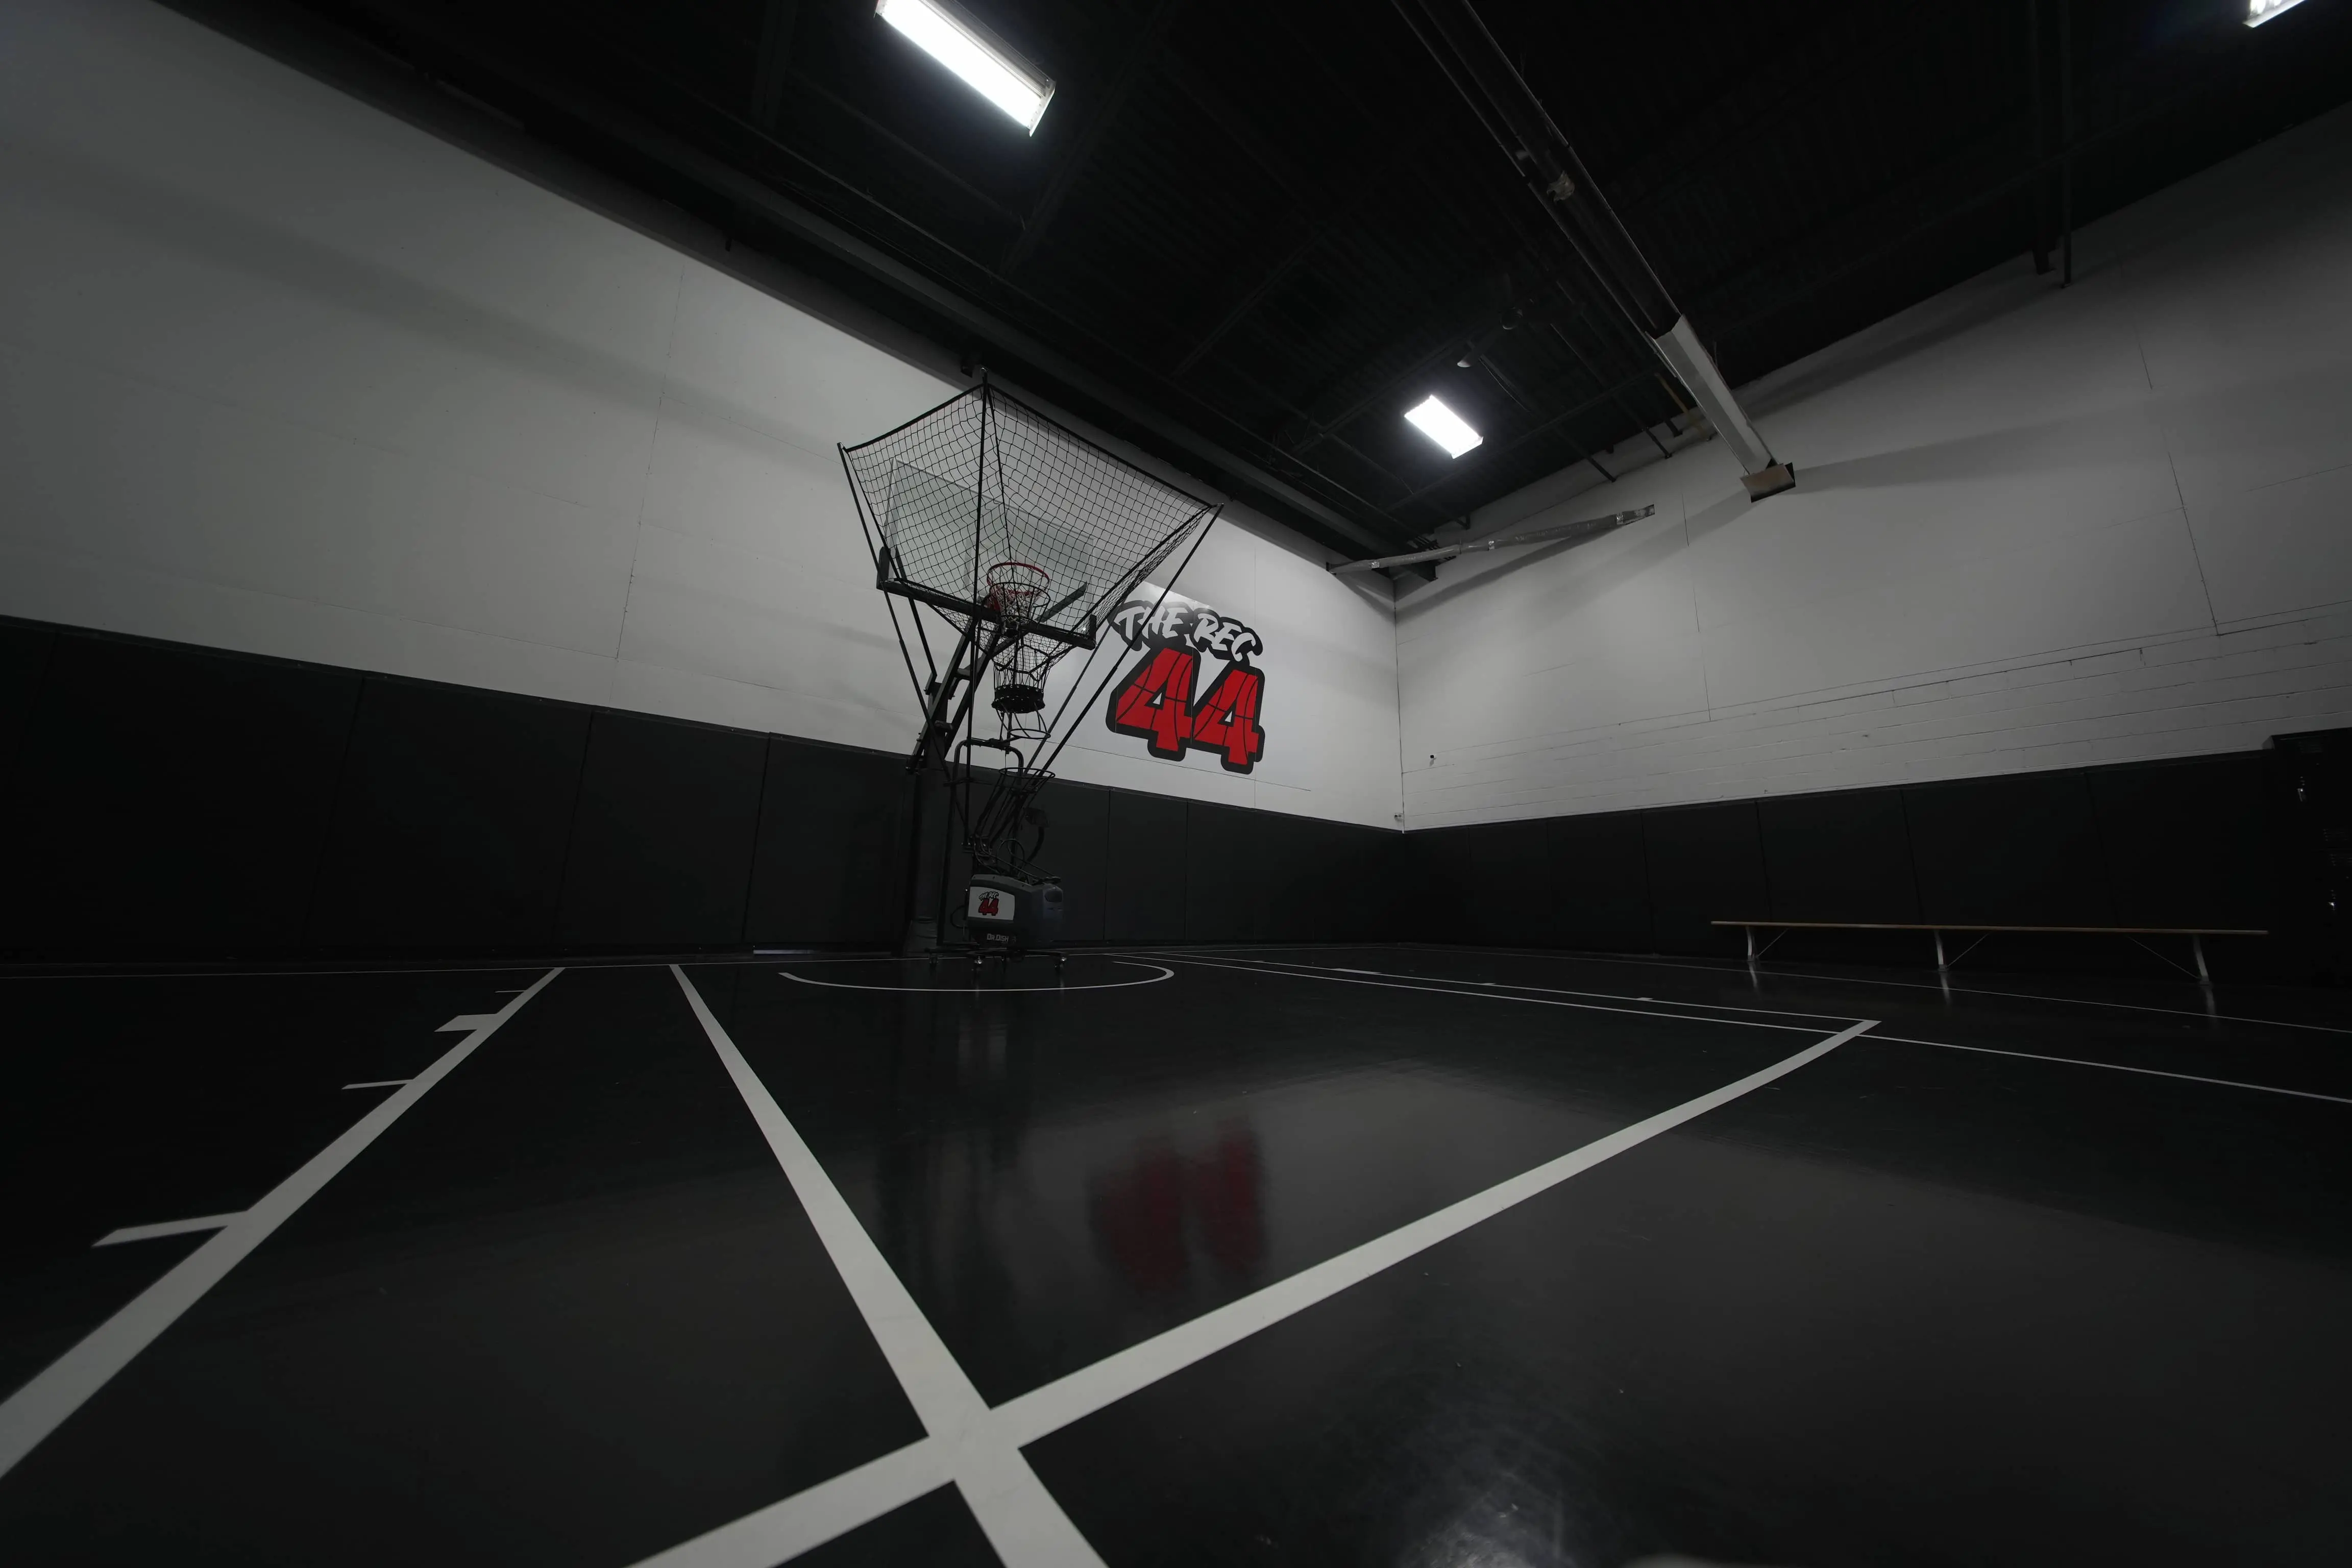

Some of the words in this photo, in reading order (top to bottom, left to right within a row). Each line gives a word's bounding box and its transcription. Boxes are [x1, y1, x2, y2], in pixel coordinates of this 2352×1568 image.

[1113, 604, 1186, 641] THE
[1193, 611, 1258, 663] REC
[1115, 646, 1261, 767] 44
[978, 898, 999, 916] 44
